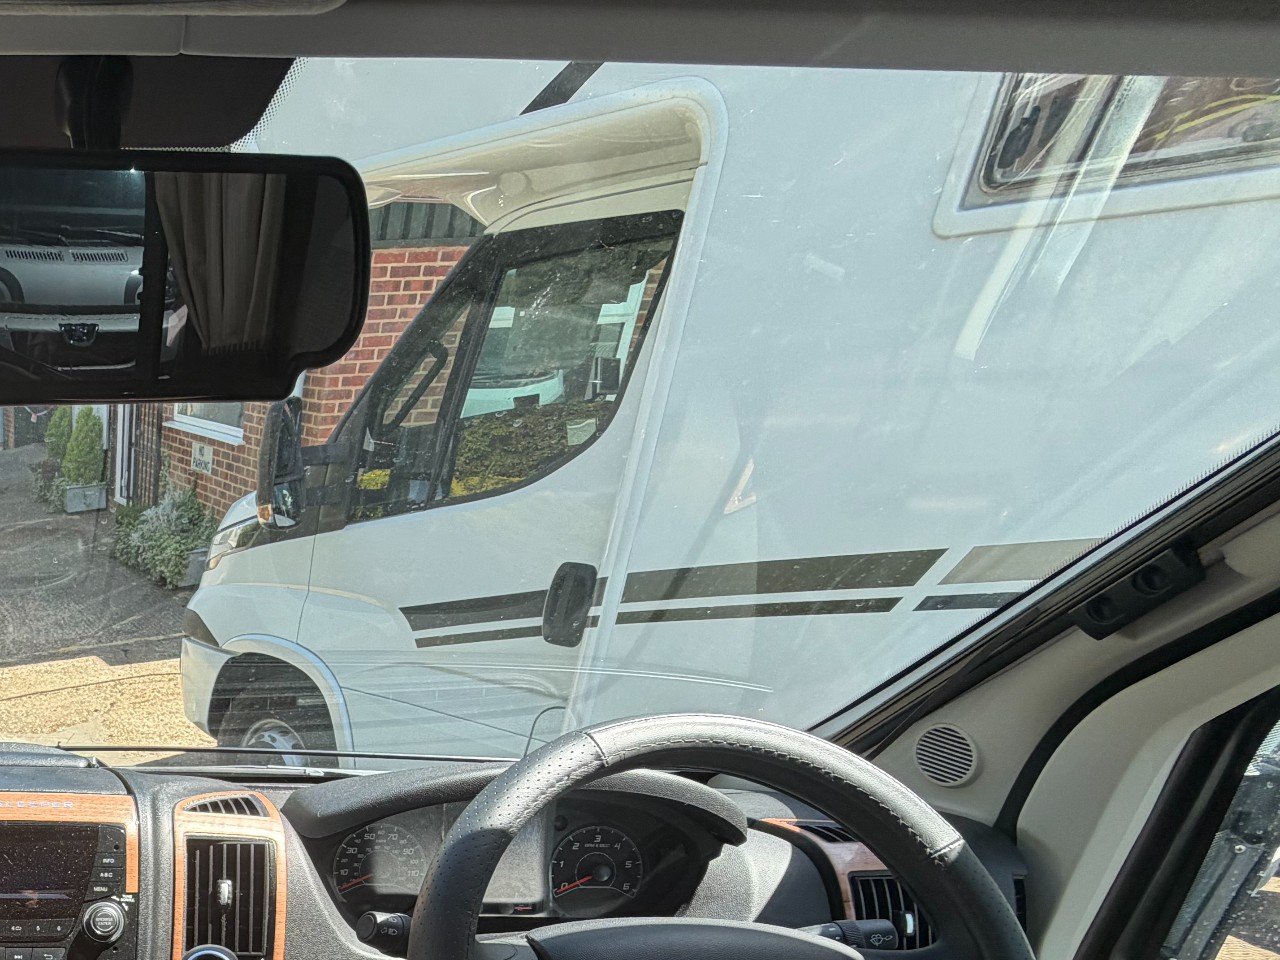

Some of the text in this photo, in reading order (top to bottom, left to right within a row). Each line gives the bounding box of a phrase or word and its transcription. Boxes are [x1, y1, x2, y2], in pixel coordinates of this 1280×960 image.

[594, 835, 602, 843] 3
[572, 842, 580, 850] 2
[614, 842, 622, 851] 4
[559, 860, 565, 868] 1
[625, 860, 633, 868] 5
[340, 868, 349, 876] 10
[623, 882, 631, 890] 6
